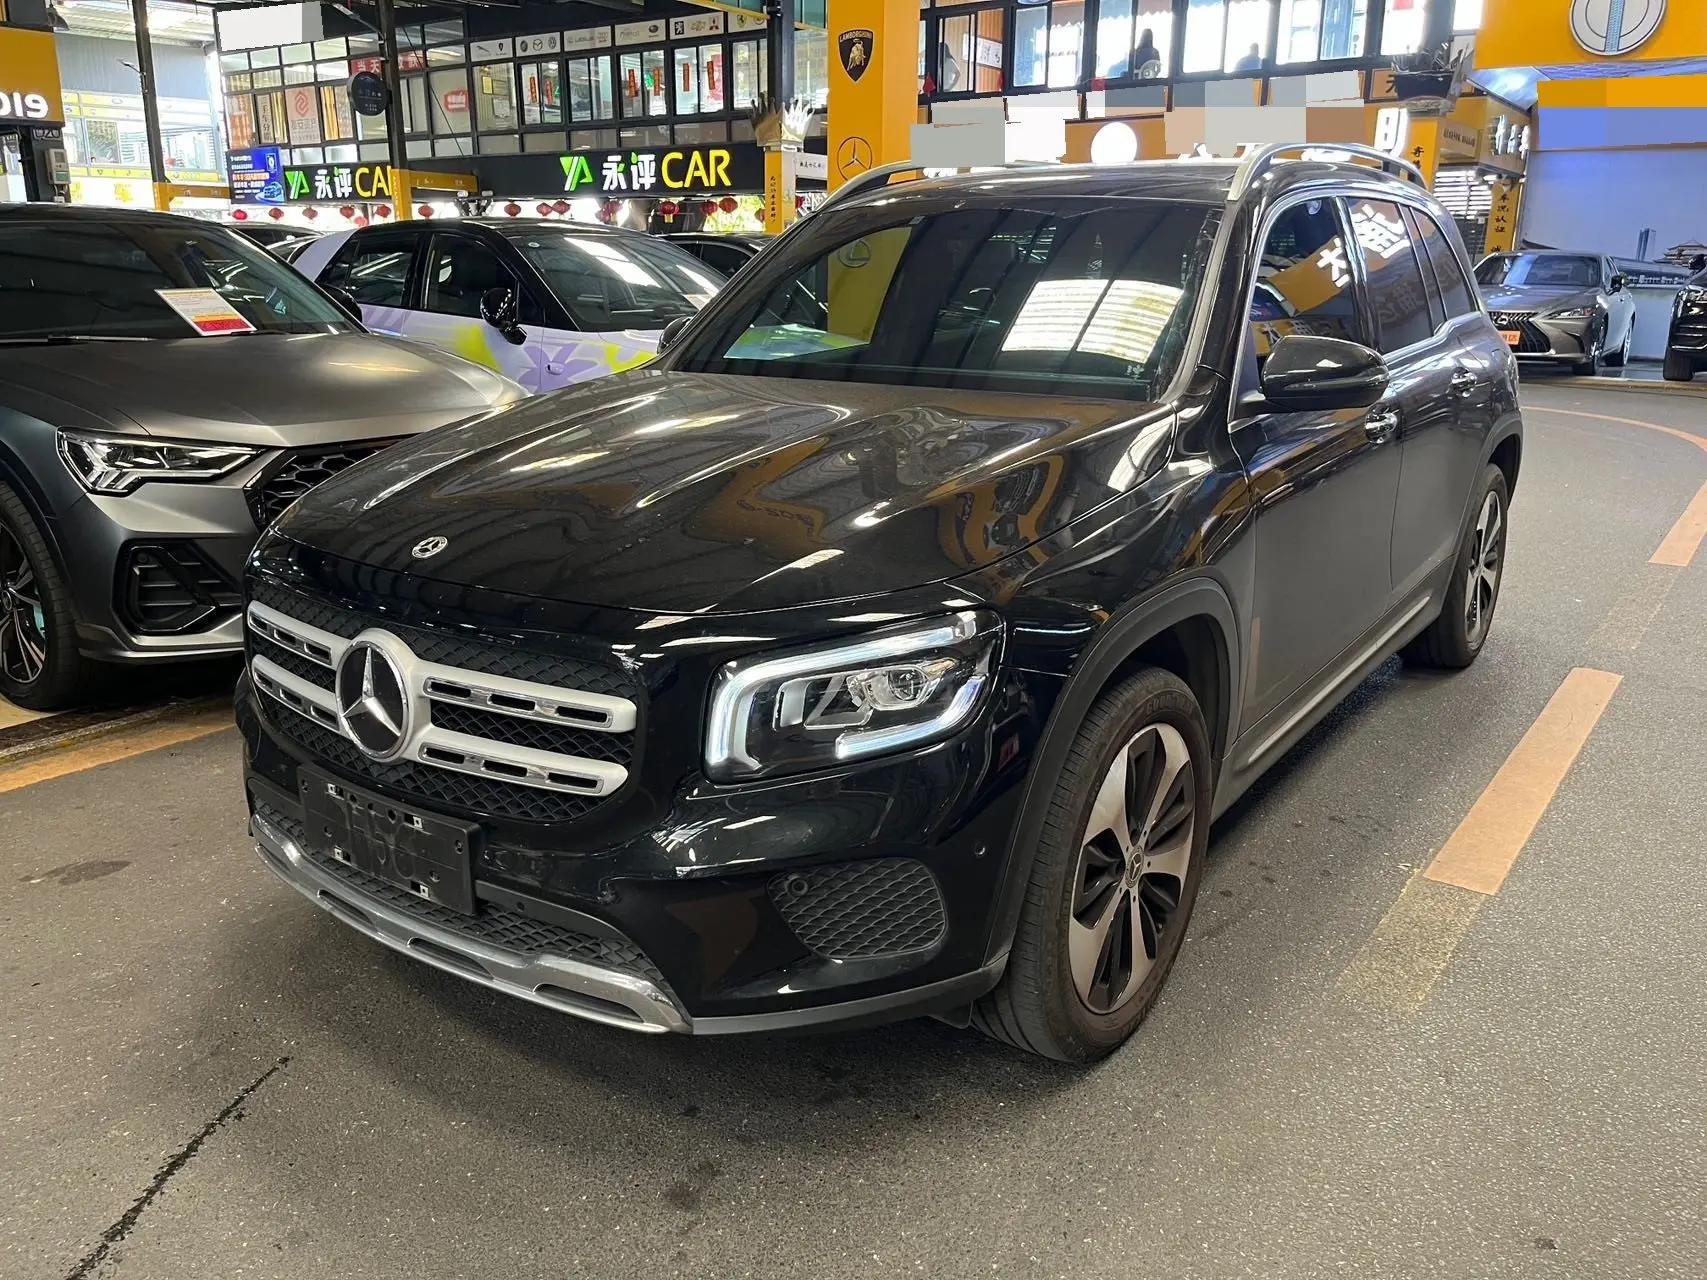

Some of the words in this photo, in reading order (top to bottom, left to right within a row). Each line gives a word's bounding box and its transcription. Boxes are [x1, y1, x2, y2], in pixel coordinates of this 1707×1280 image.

[315, 167, 352, 199] 永评
[602, 152, 656, 191] 永评
[661, 149, 732, 188] CAR
